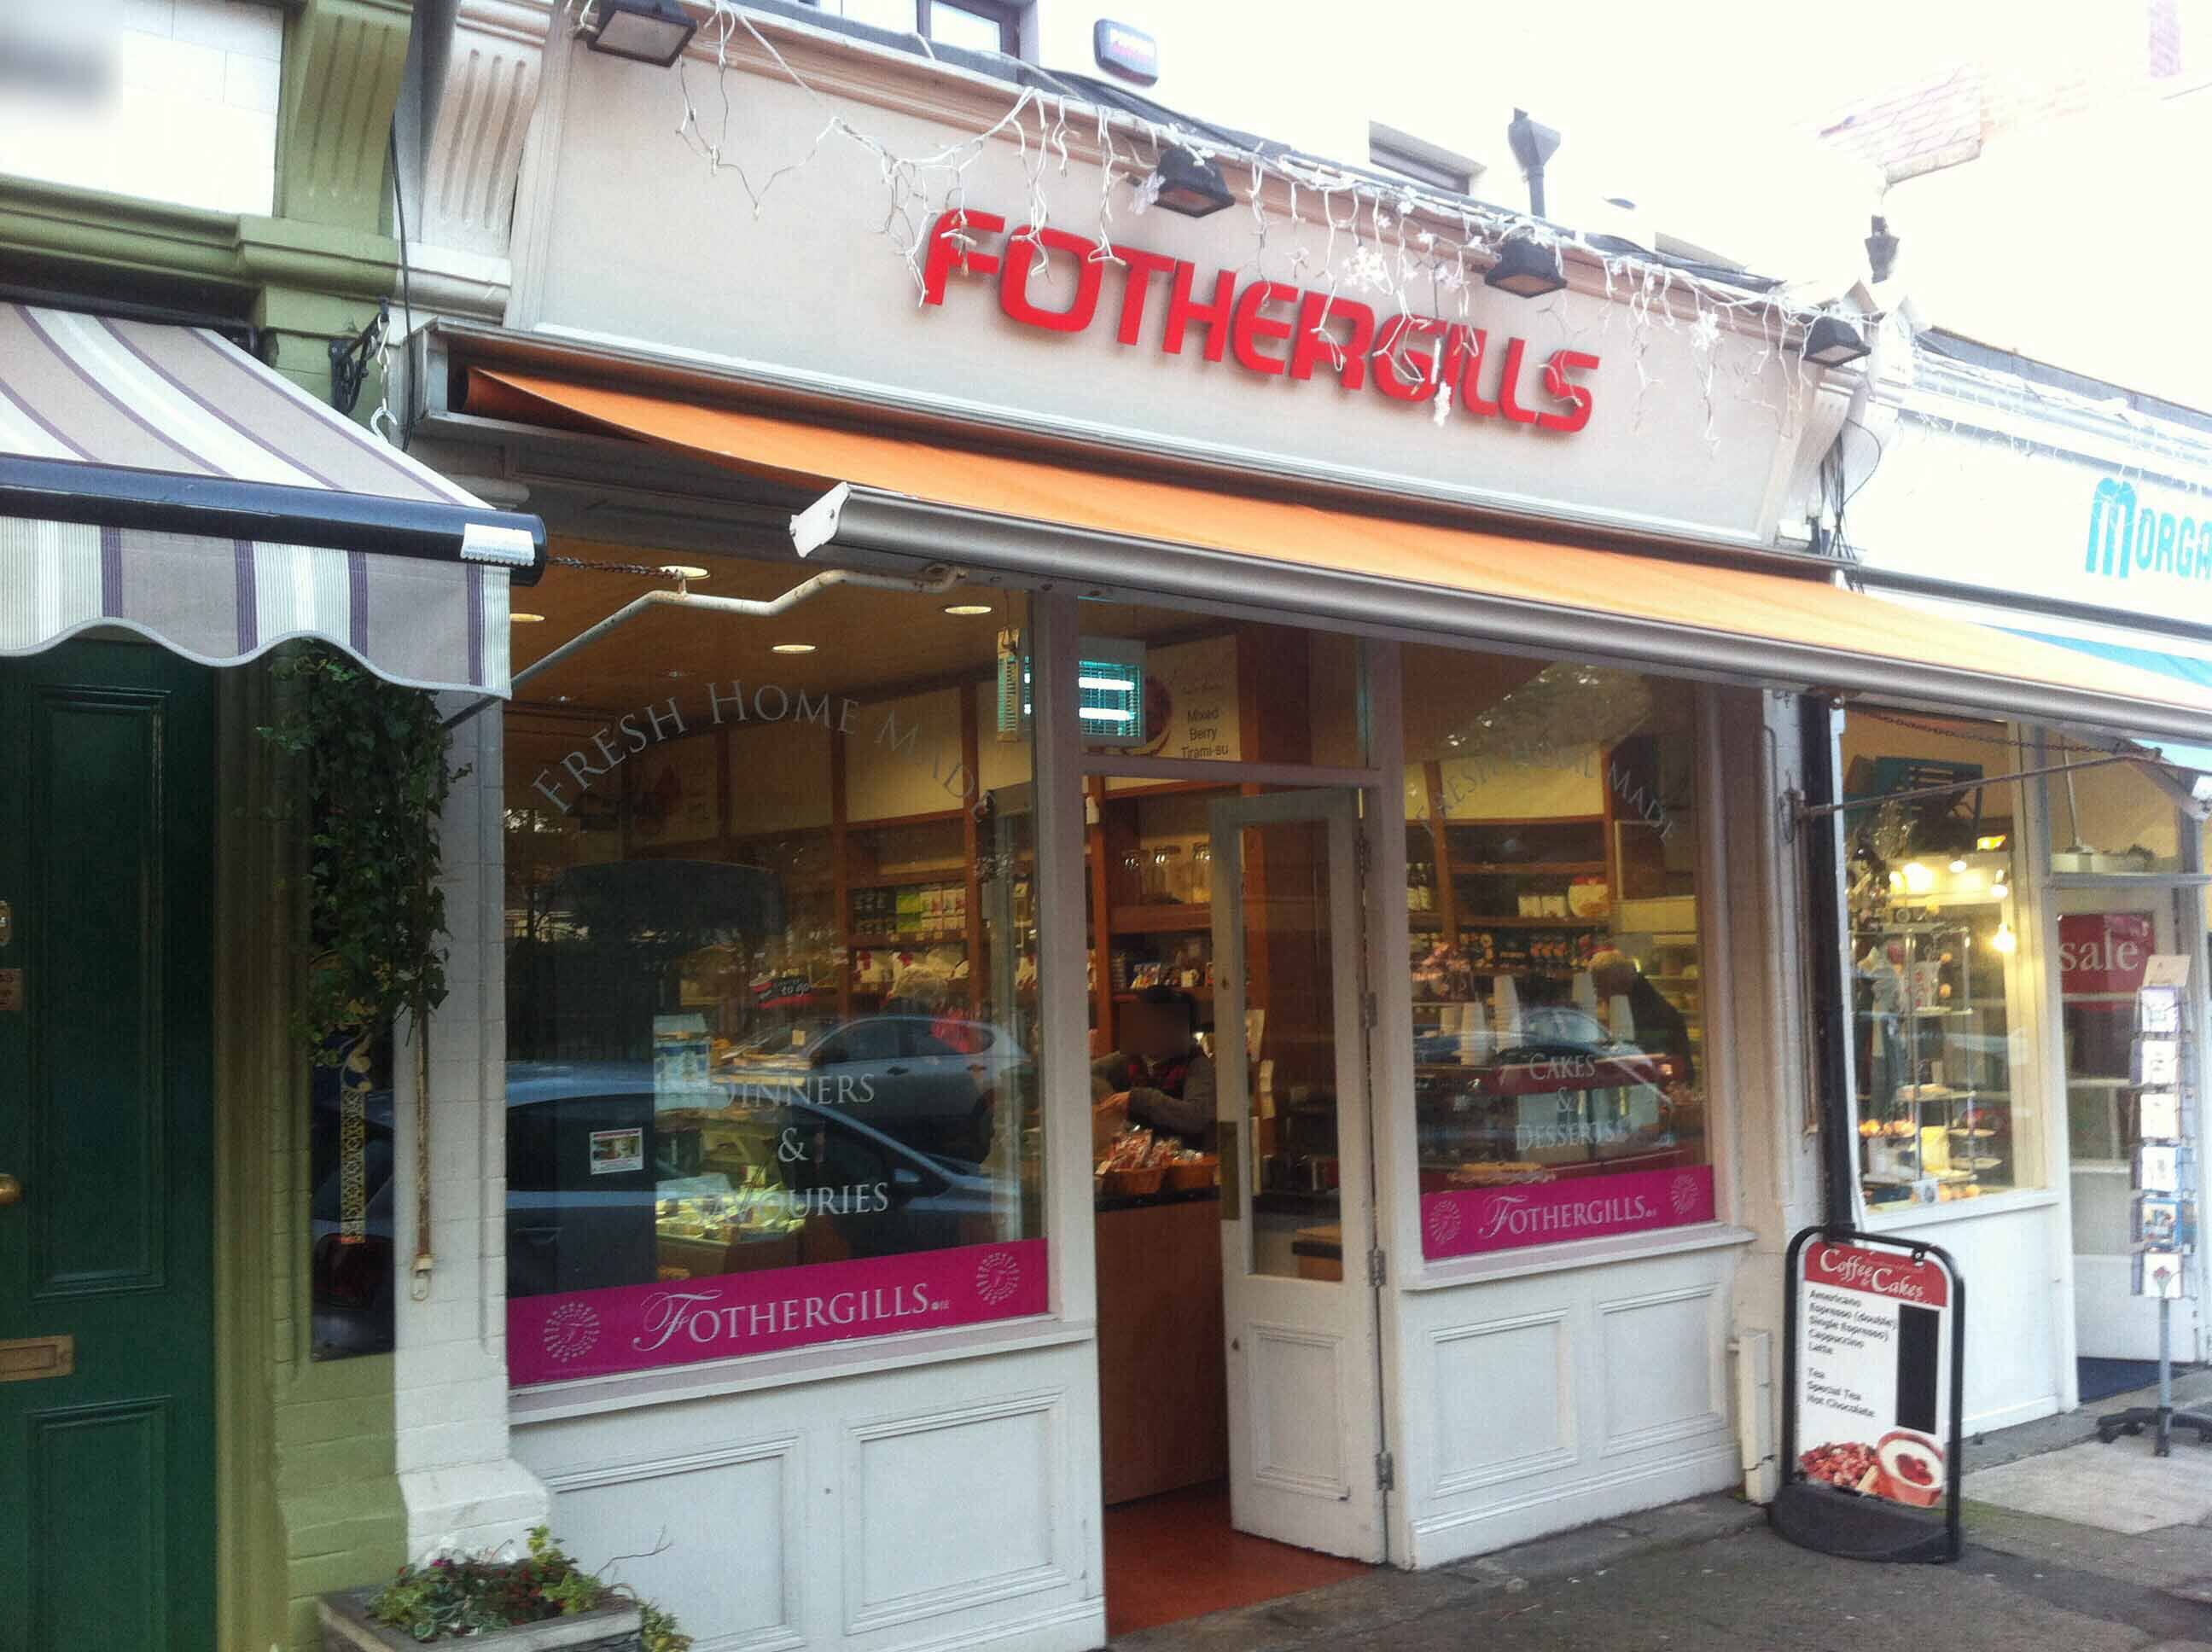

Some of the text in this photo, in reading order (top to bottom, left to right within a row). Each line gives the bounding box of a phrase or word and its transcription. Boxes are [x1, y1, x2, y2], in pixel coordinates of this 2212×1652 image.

[923, 207, 1600, 433] FOTHERGILLS
[531, 696, 688, 813] FRESH
[709, 679, 860, 736] HOME
[1188, 726, 1219, 742] Berry
[2059, 927, 2139, 971] sale
[1528, 1052, 1596, 1081] CAKES
[777, 1126, 810, 1162] &
[1819, 1248, 1875, 1283] Coffee
[1871, 1267, 1925, 1299] Cakes
[1807, 1367, 1825, 1379] Tea
[1843, 1389, 1862, 1401] Tea
